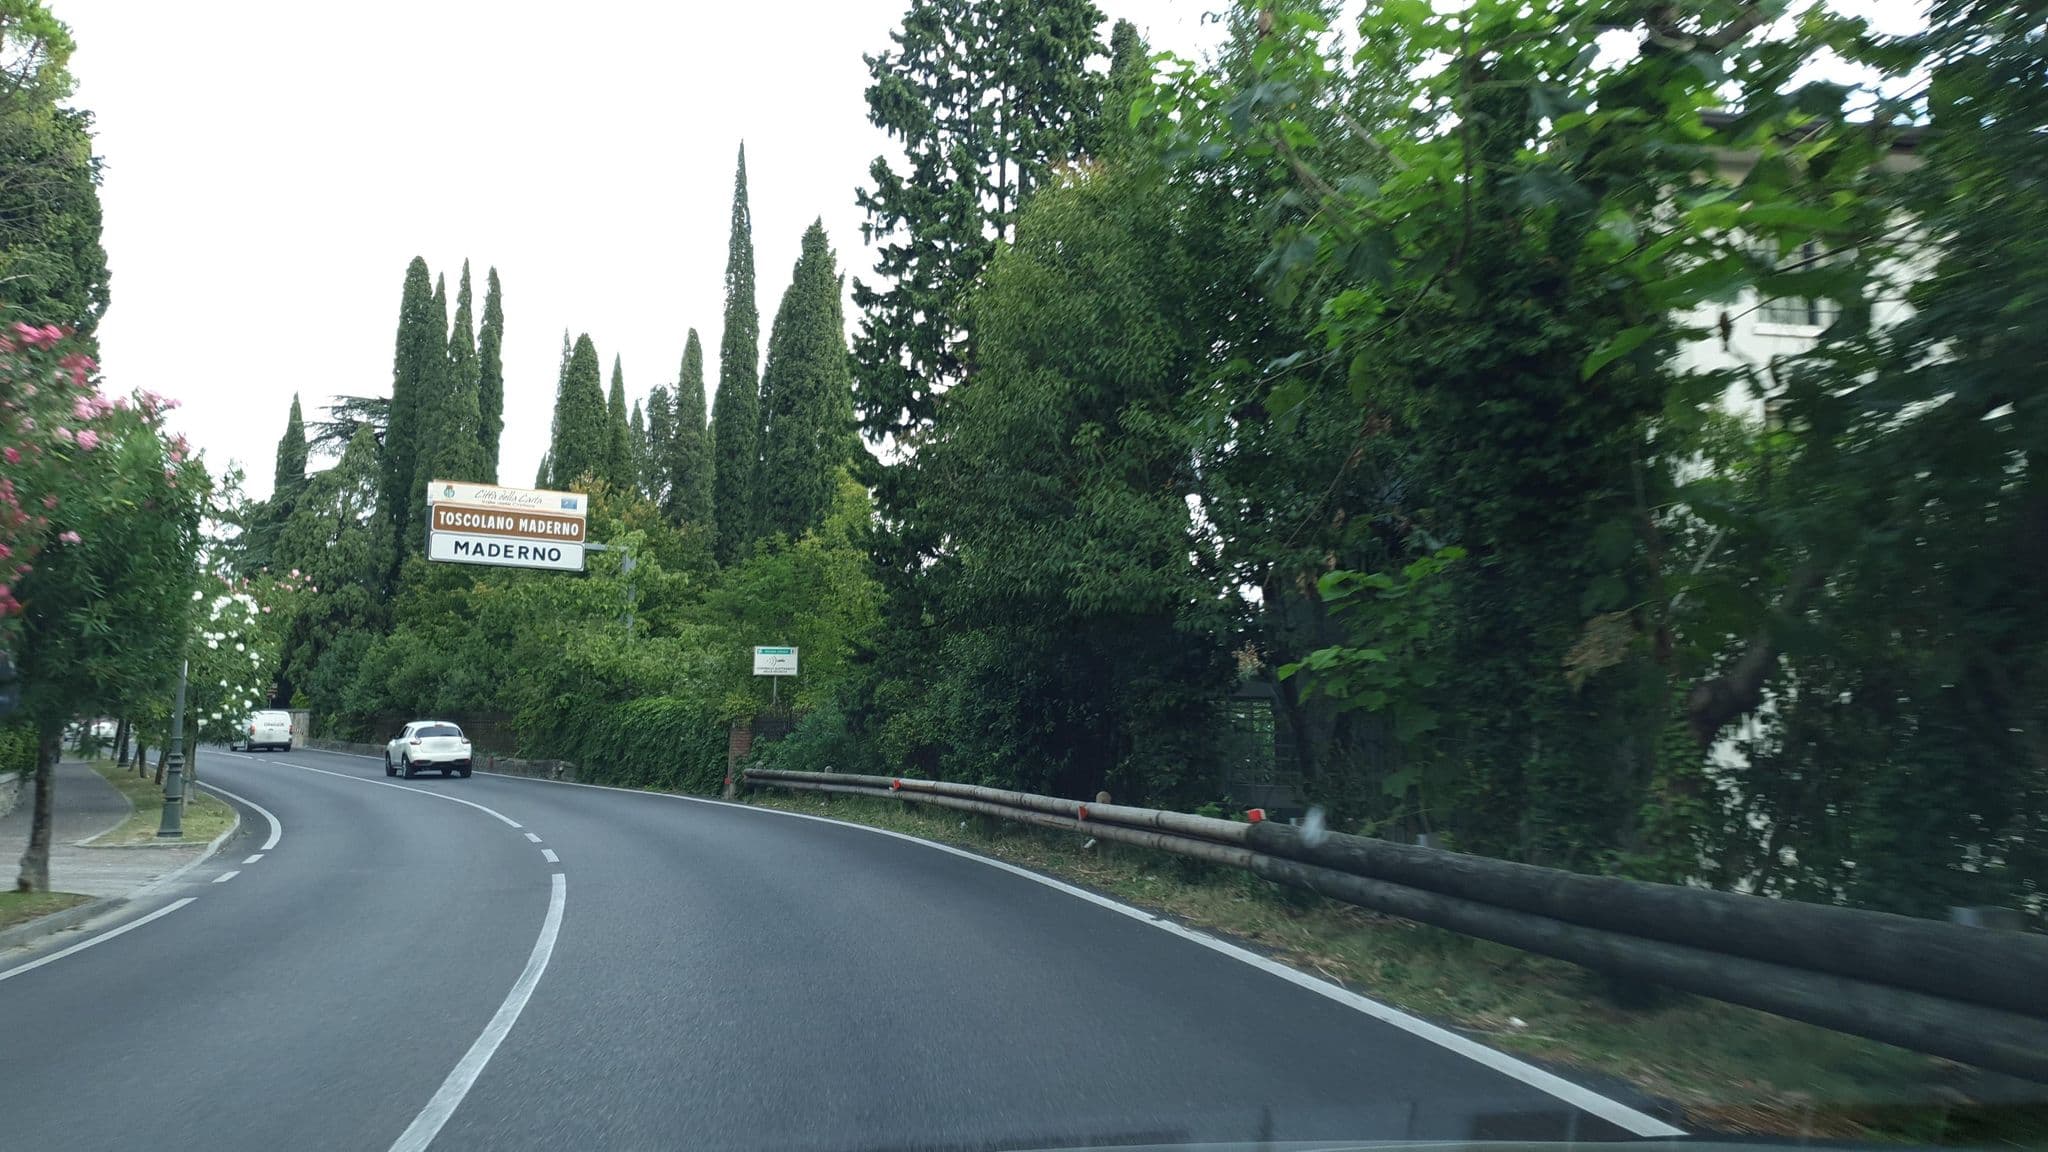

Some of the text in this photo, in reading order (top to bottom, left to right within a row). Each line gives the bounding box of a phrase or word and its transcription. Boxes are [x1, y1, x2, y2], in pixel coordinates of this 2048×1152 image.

[440, 511, 579, 536] TOSCOLANO MADERNO
[454, 540, 561, 562] MADERNO
